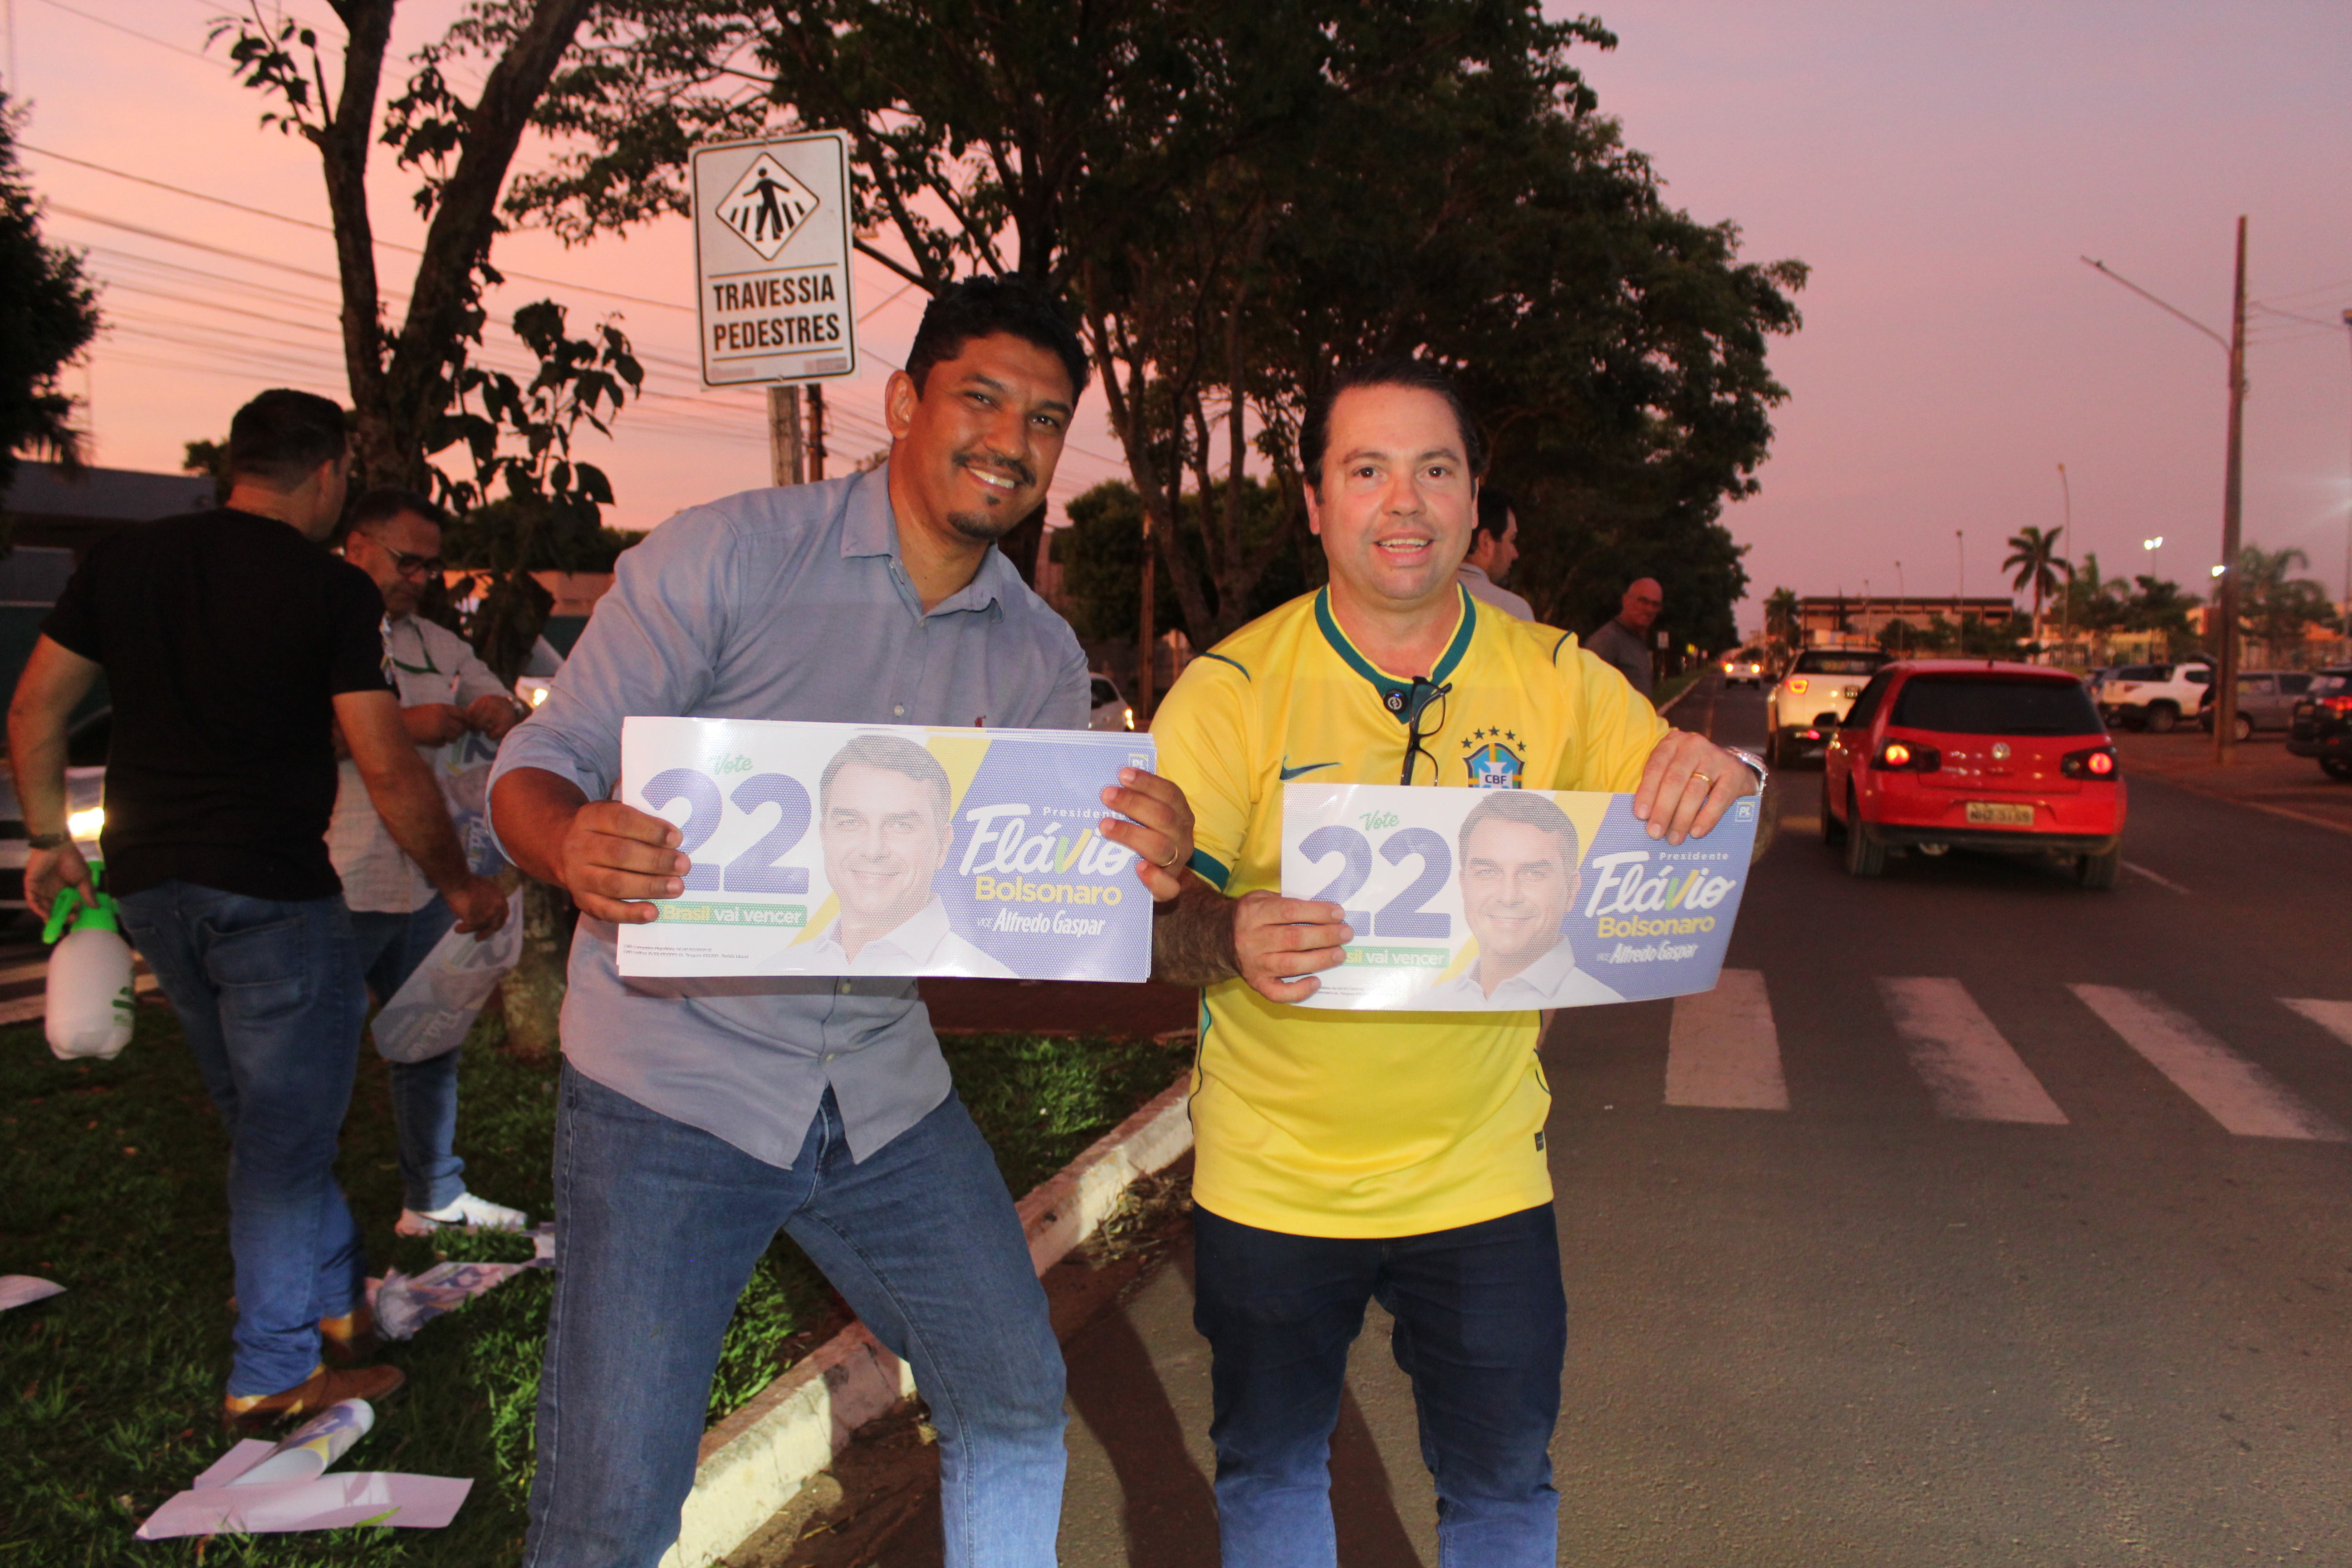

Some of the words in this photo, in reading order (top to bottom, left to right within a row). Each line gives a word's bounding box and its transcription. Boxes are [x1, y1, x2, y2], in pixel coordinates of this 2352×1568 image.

[713, 274, 835, 312] TRAVESSIA
[713, 313, 840, 351] PEDESTRES
[707, 752, 754, 775] Vote
[1485, 774, 1508, 784] CBF
[1359, 810, 1400, 831] Vote
[1738, 806, 1751, 817] PL
[641, 768, 812, 895] 22
[960, 804, 1140, 876] Flávio
[1659, 851, 1729, 861] Presidente
[975, 877, 1122, 905] Bolsonaro
[1299, 825, 1452, 938] 22
[1585, 851, 1737, 918] Flávio
[663, 904, 710, 921] Brasil
[714, 906, 740, 923] vai
[743, 910, 802, 924] vencer
[993, 908, 1050, 933] Alfredo
[1053, 910, 1106, 937] Gaspar
[1597, 916, 1716, 939] Bolsonaro
[1346, 949, 1362, 963] sil
[1365, 949, 1389, 964] vai
[1392, 953, 1446, 965] vencer
[1609, 943, 1658, 964] Alfredo
[1657, 940, 1699, 962] Gaspar
